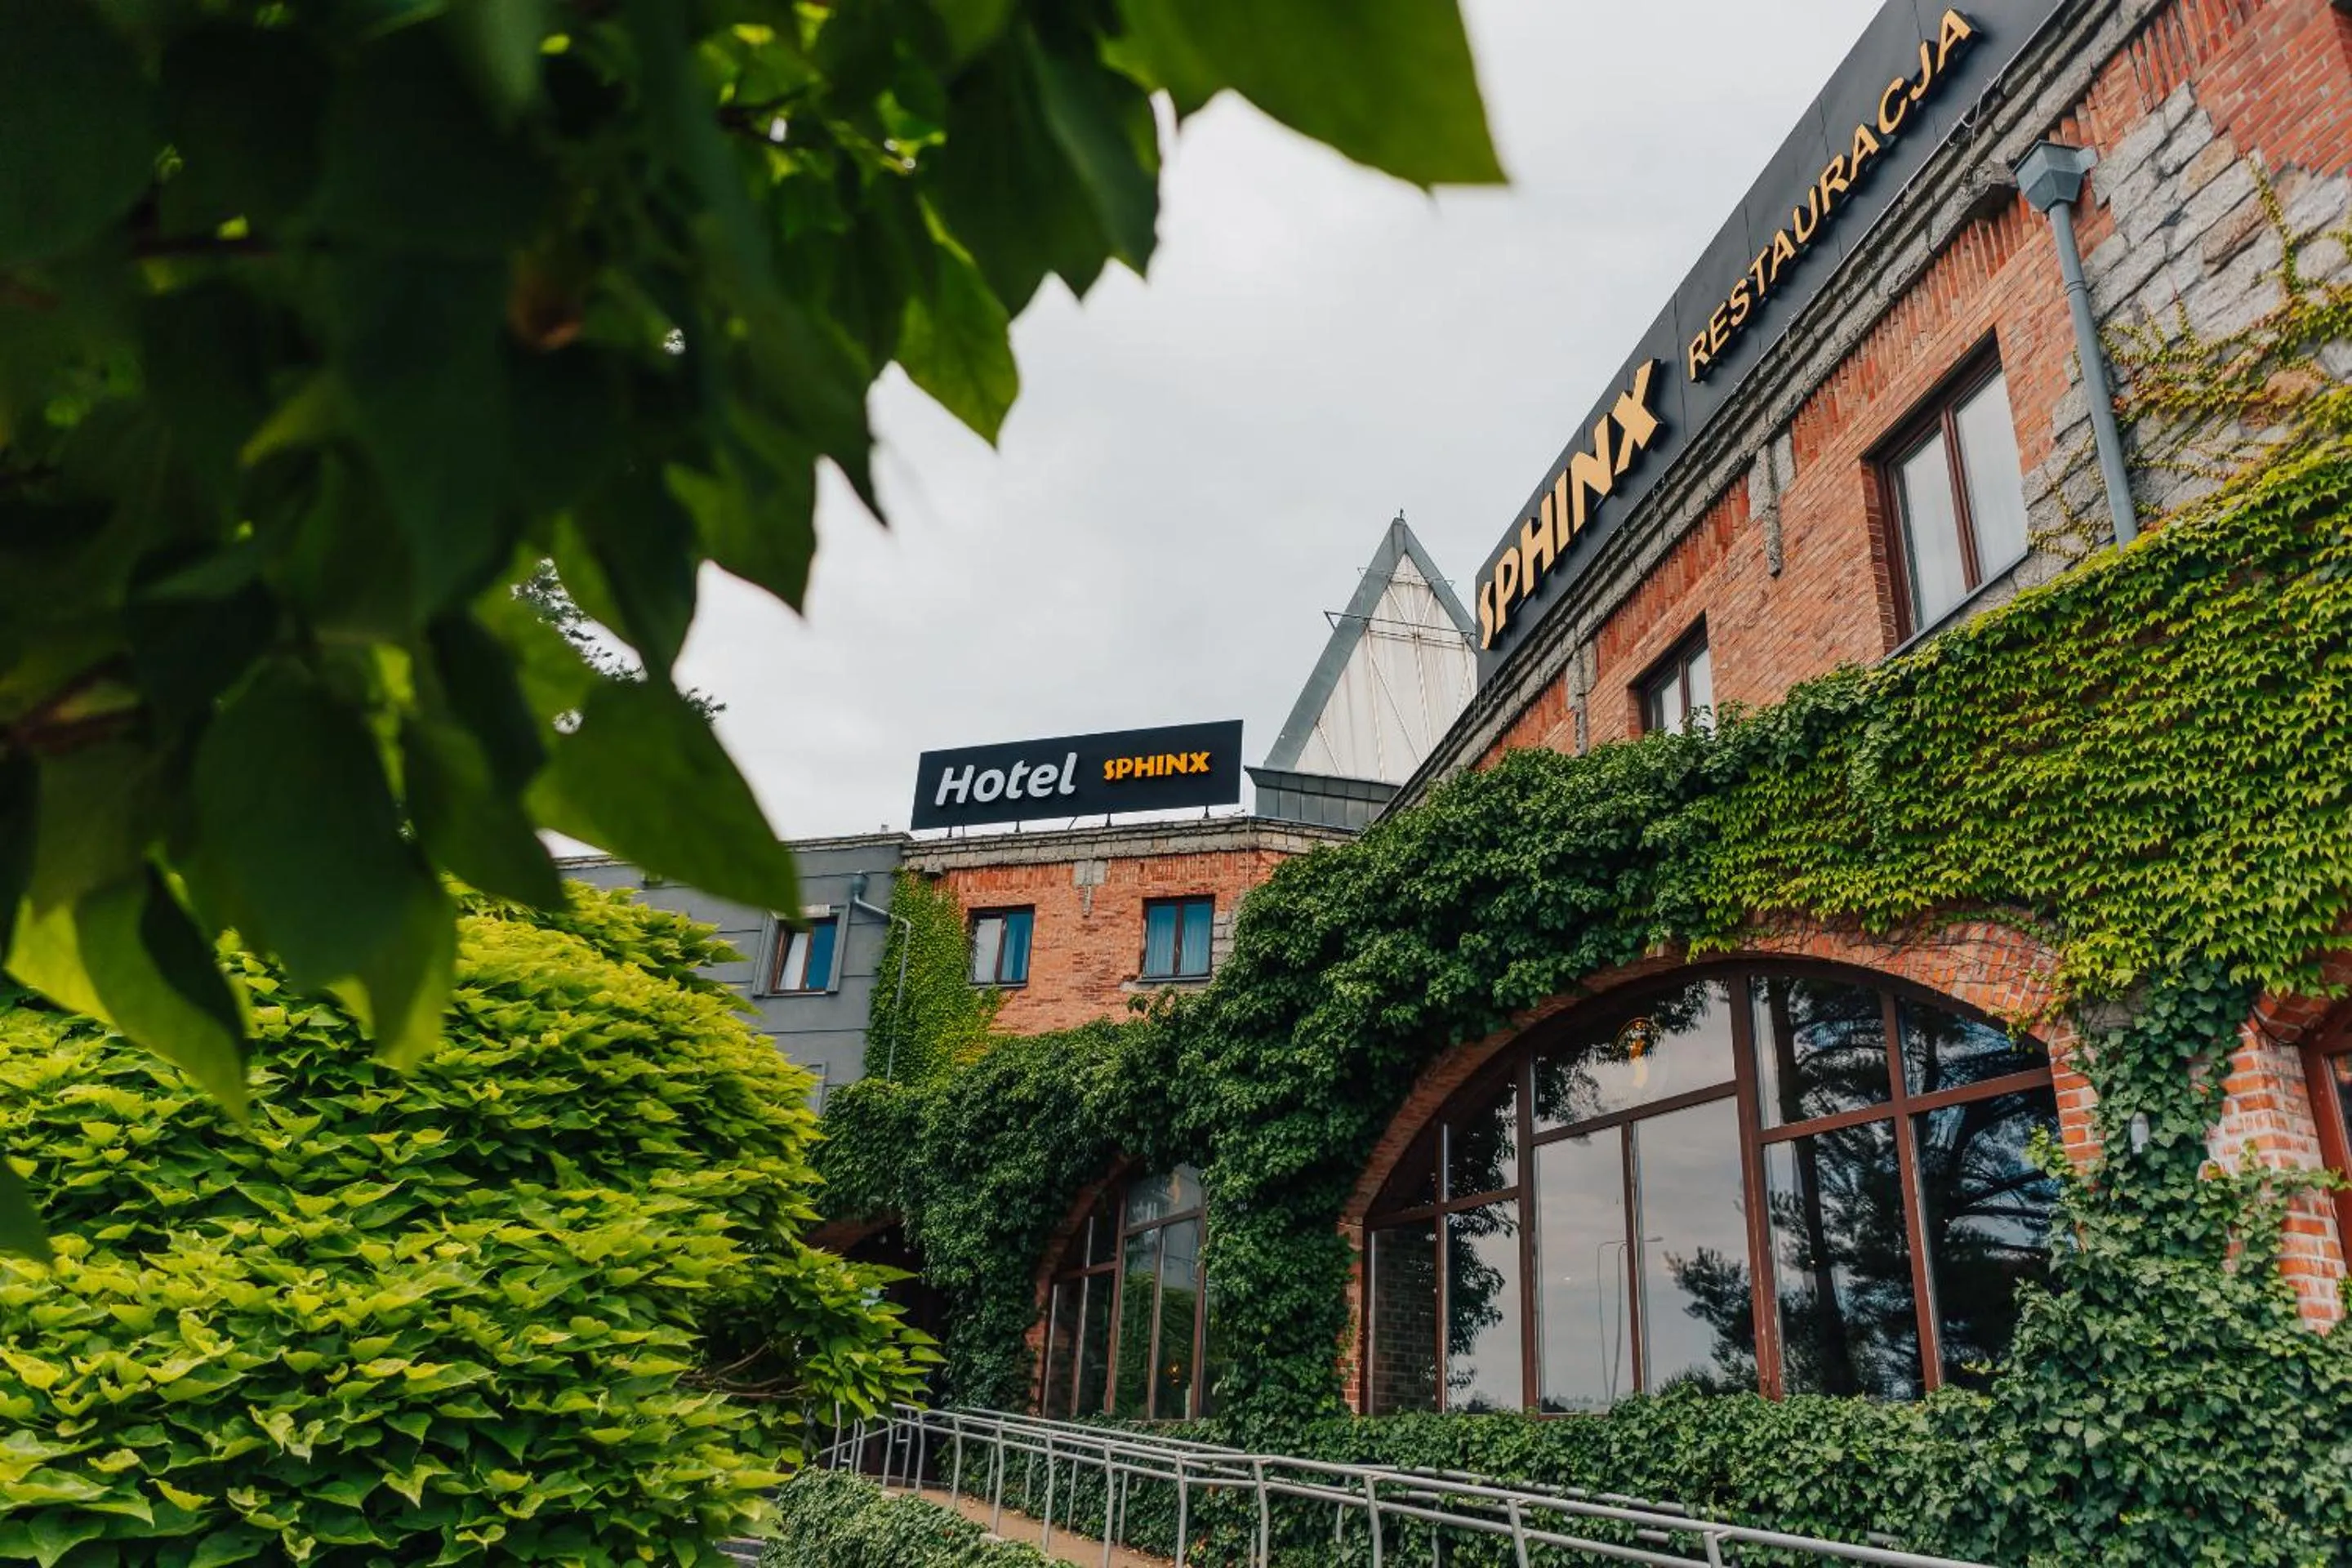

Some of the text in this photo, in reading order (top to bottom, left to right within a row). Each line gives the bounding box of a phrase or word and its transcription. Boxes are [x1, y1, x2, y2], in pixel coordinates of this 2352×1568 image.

[1479, 8, 1973, 650] SPHINX RESTAURACJA
[934, 751, 1211, 806] Hotel SPHINX
